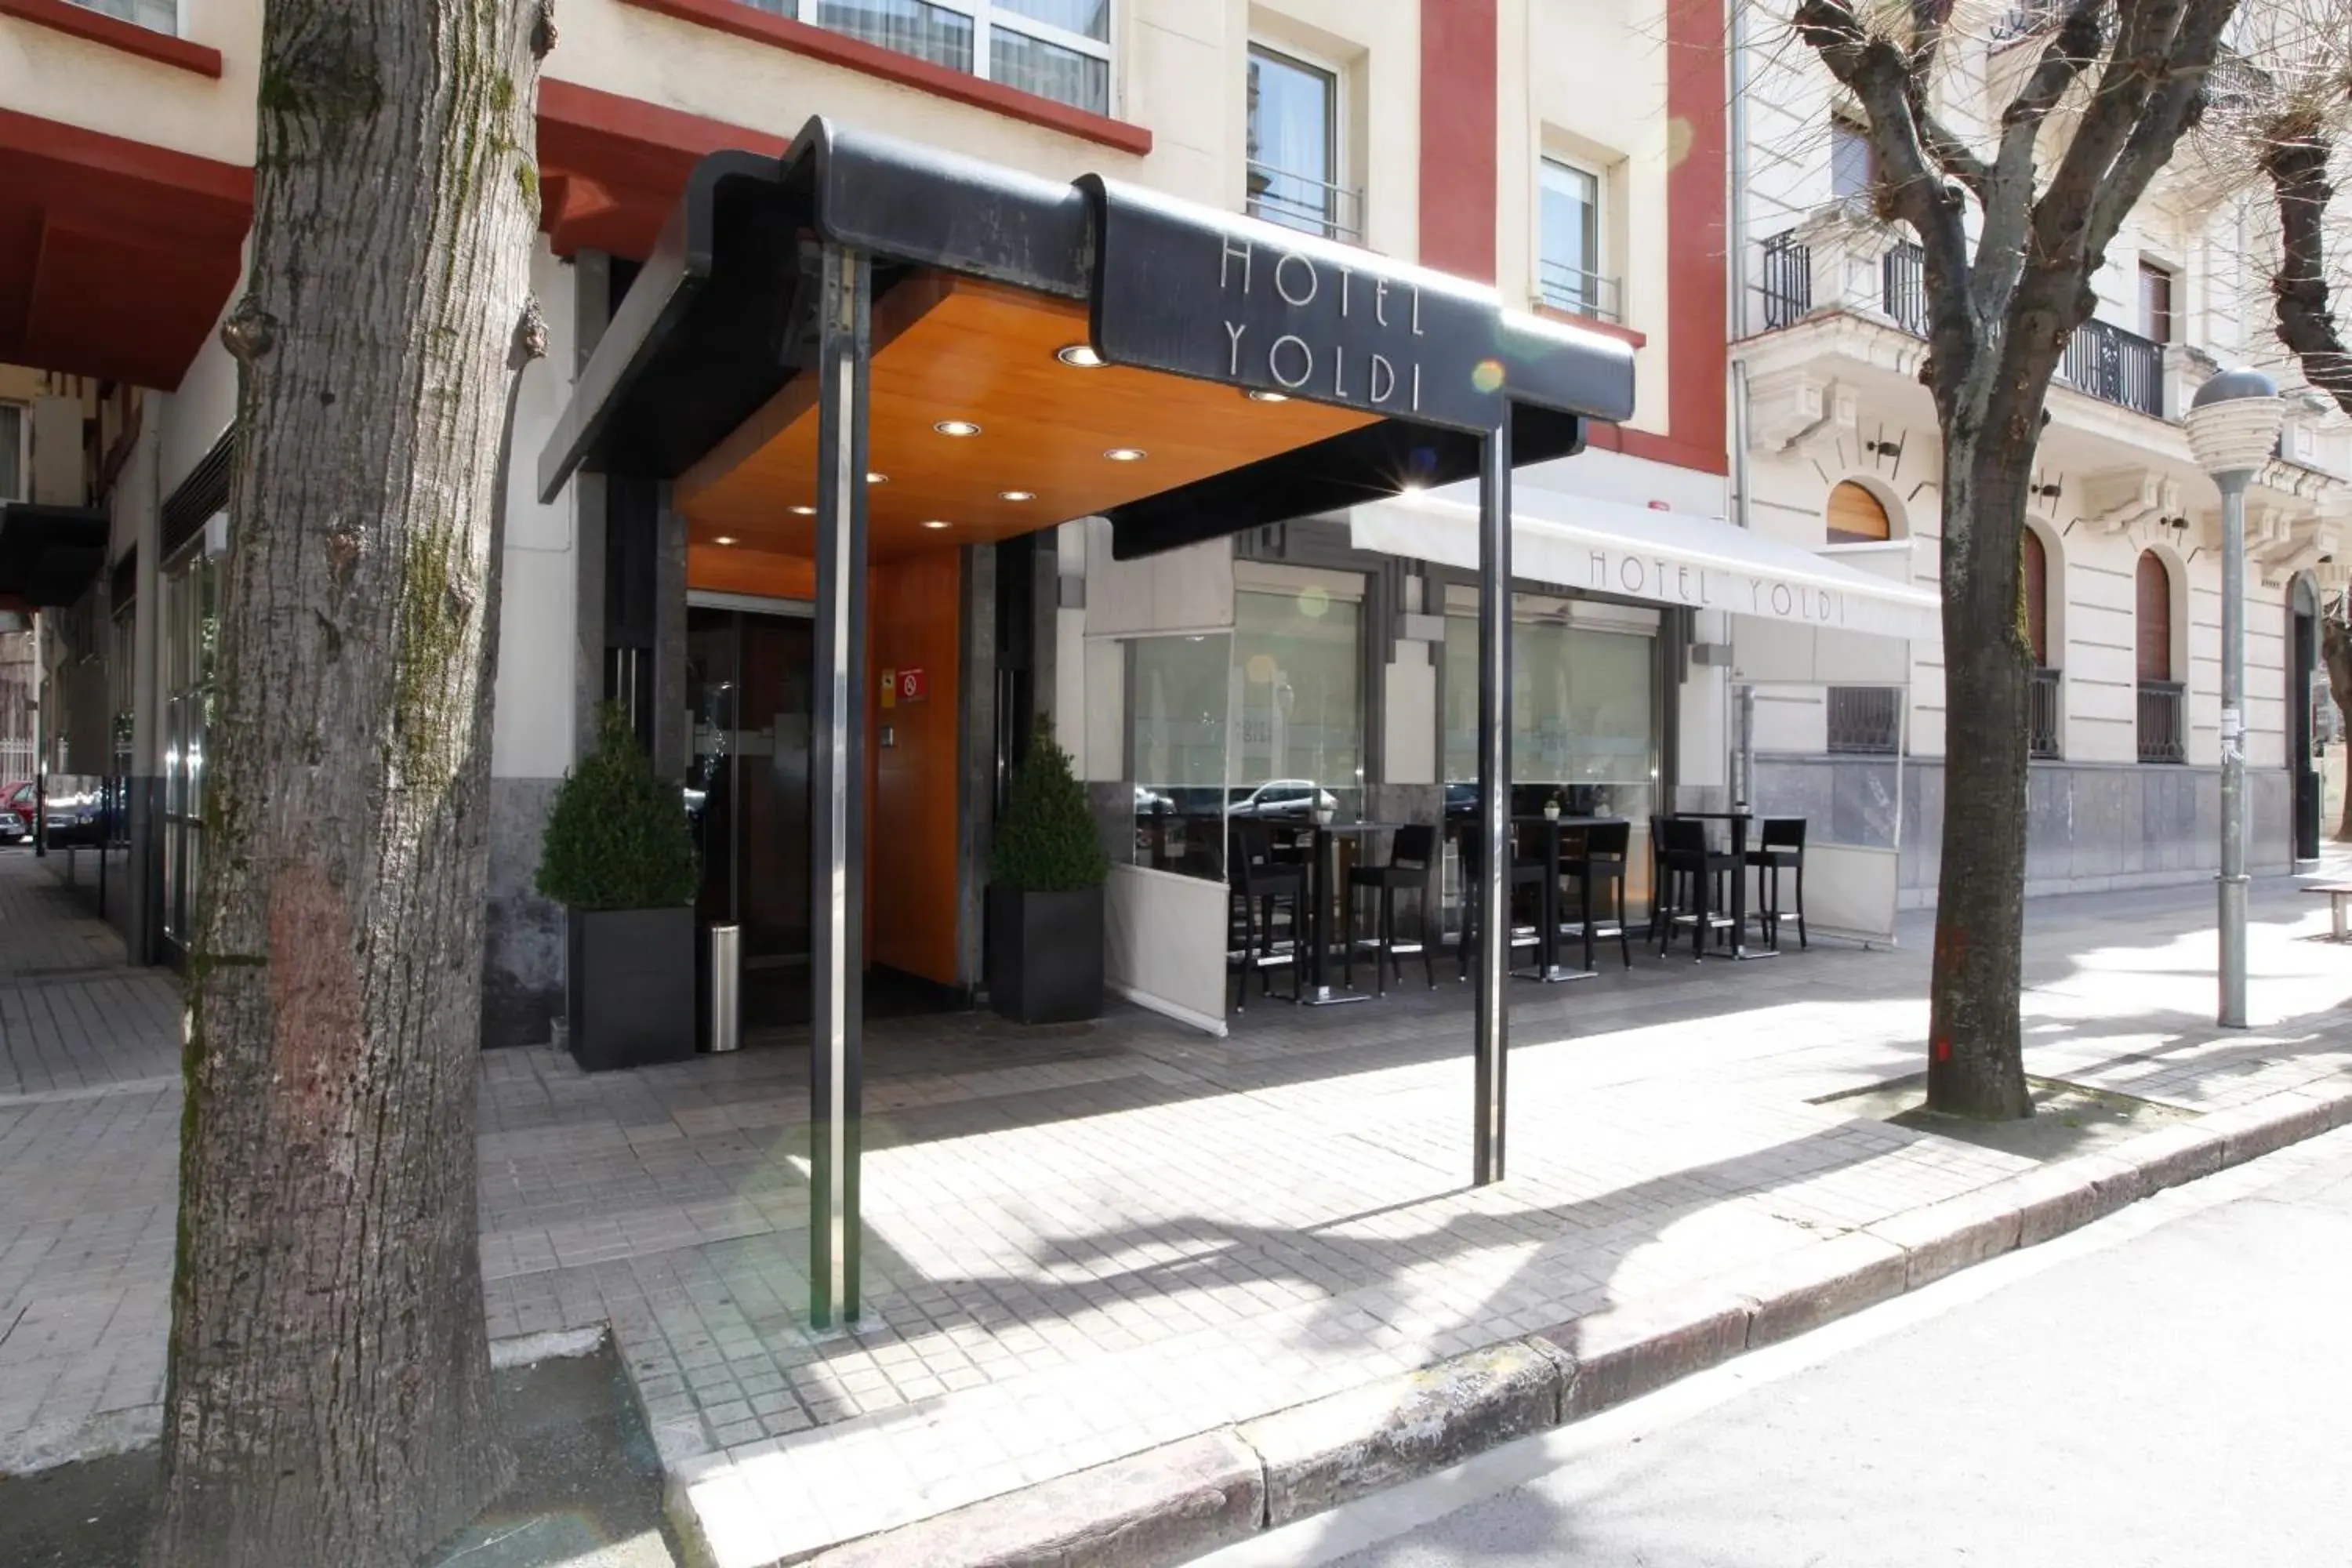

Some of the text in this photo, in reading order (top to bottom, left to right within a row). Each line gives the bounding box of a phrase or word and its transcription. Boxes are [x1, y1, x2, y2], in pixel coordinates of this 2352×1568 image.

[1221, 235, 1424, 336] HOTEL
[1225, 321, 1418, 411] YOLDI
[1590, 550, 1845, 626] HOTEL YOLDI
